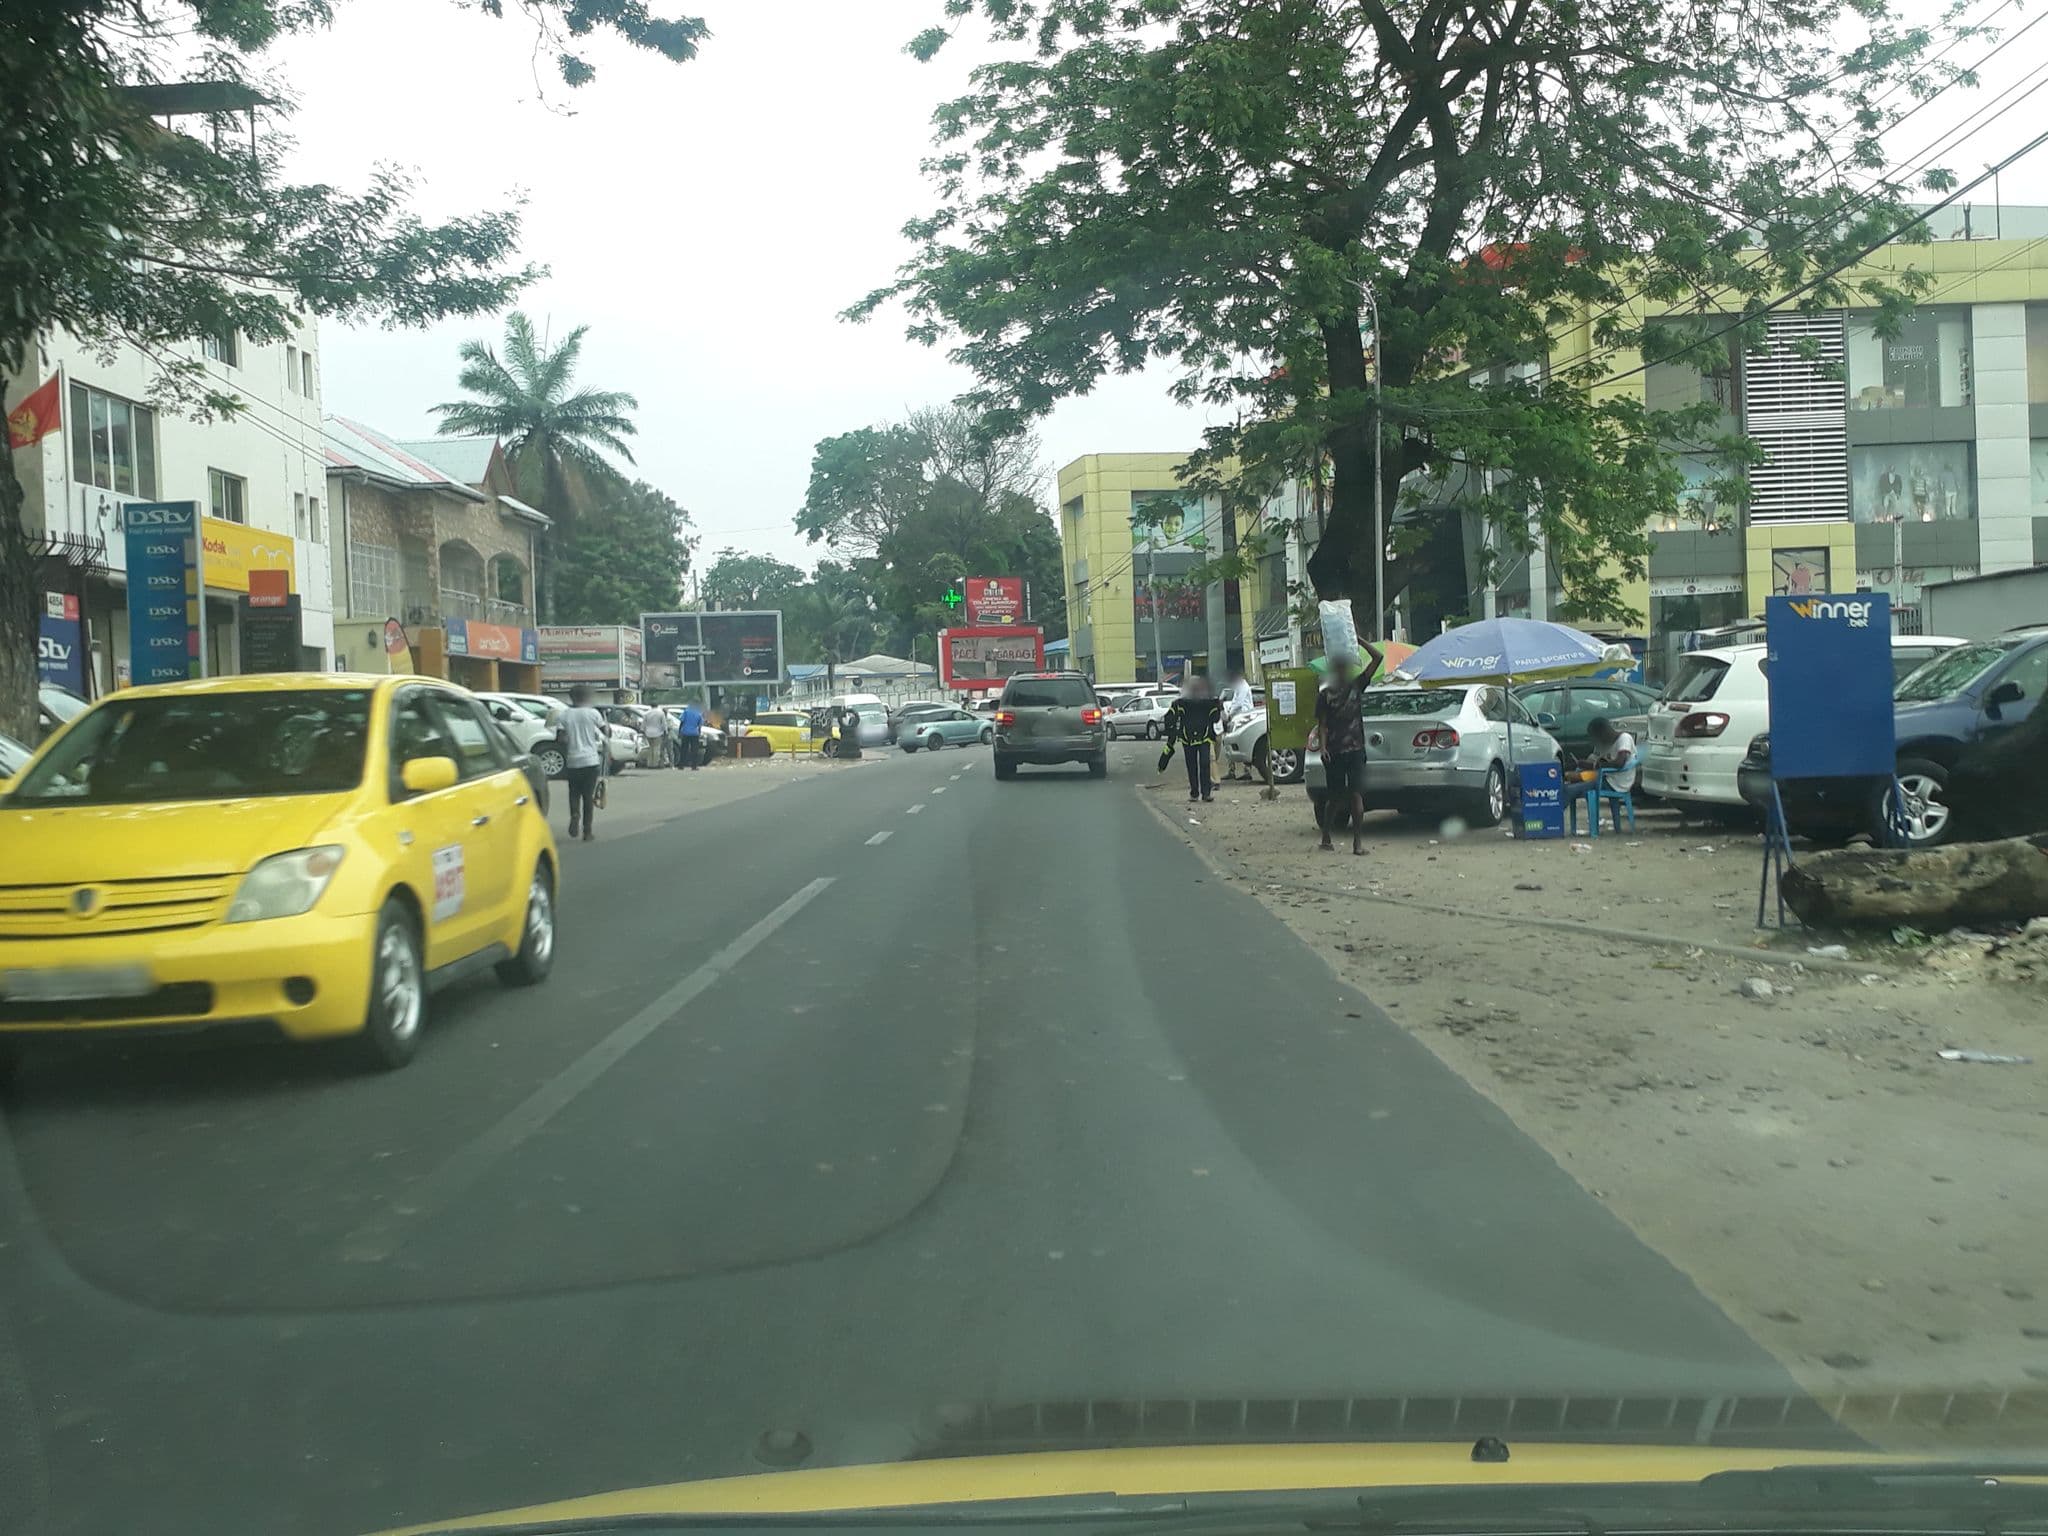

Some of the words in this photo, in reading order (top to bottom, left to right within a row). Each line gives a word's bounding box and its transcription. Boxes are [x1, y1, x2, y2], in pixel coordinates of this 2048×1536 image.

[128, 509, 191, 525] DStv
[146, 545, 180, 554] DStv
[202, 537, 227, 555] Kodak
[147, 576, 180, 585] DStv
[249, 595, 281, 605] orange
[149, 606, 182, 616] DStv
[1788, 598, 1872, 619] winner
[38, 637, 71, 660] Stv
[150, 637, 183, 647] DStv
[1515, 658, 1541, 667] PARIS
[1542, 651, 1586, 665] SPORTIFS
